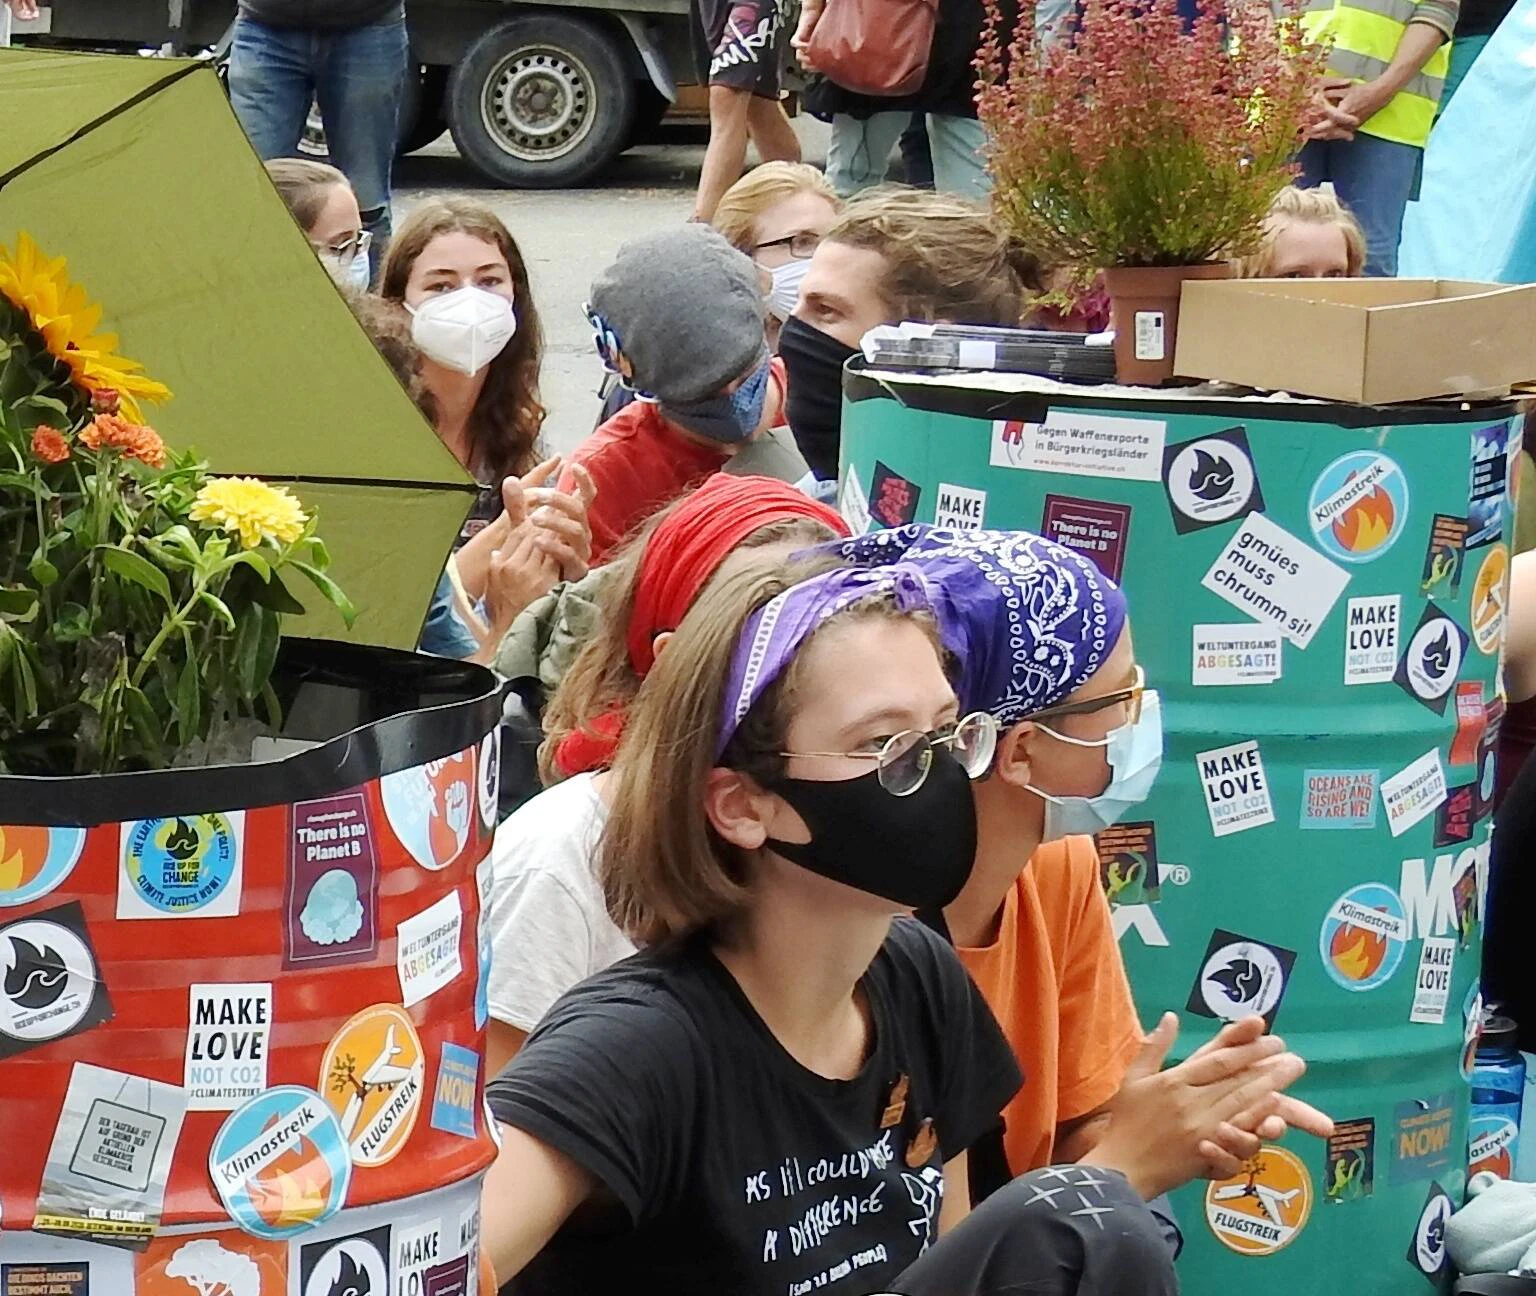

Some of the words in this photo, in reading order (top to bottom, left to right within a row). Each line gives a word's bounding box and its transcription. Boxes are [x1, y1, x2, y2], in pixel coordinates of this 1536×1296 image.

[1036, 424, 1069, 442] Gegen
[1070, 428, 1150, 447] Waffenexporte
[1034, 440, 1046, 451] in
[1046, 441, 1149, 461] Bürgerkriegsländer
[939, 492, 982, 518] MAKE
[1314, 464, 1387, 524] Klimastreik
[1051, 519, 1087, 538] There
[1088, 523, 1100, 538] is
[1101, 527, 1118, 540] no
[1057, 533, 1096, 550] Planet
[1097, 537, 1108, 551] B
[1236, 529, 1301, 577] gmües
[1227, 547, 1277, 587] muss
[1212, 567, 1289, 625] chrumm
[1287, 615, 1313, 639] si!
[1349, 604, 1397, 627] MAKE
[1196, 639, 1279, 652] WELTUNTERGANG
[1349, 626, 1396, 651] LOVE
[1196, 652, 1278, 671] ABGESAGT!
[1348, 652, 1373, 666] NOT
[1375, 651, 1395, 665] CO2
[1202, 748, 1258, 781] MAKE
[1207, 770, 1264, 803] LOVE
[1308, 773, 1353, 792] OCEANS
[1353, 773, 1373, 787] ARE
[1386, 763, 1440, 805] WELTUNTERGANG
[1212, 799, 1241, 818] NOT
[1242, 793, 1267, 811] CO2
[1307, 789, 1347, 807] RISING
[1348, 786, 1373, 802] AND
[1306, 806, 1323, 818] SO
[1325, 803, 1347, 818] ARE
[1349, 802, 1371, 818] WE!
[296, 826, 338, 845] There
[339, 821, 350, 838] is
[350, 822, 367, 837] no
[306, 843, 351, 863] Planet
[351, 840, 362, 857] B
[162, 870, 200, 884] CHANGE
[1337, 902, 1402, 936] Klimastreik
[1422, 945, 1452, 968] MAKE
[1418, 967, 1449, 994] LOVE
[194, 996, 267, 1026] MAKE
[190, 1030, 265, 1061] LOVE
[190, 1066, 225, 1085] NOT
[229, 1065, 262, 1084] CO2
[360, 1076, 418, 1158] FLUGSTREIK
[220, 1105, 316, 1185] Klimastreik
[1398, 1119, 1454, 1162] NOW!
[1469, 1129, 1512, 1159] astreik
[1213, 1211, 1283, 1243] FLUGSTREIK
[398, 1230, 440, 1270] MAKE
